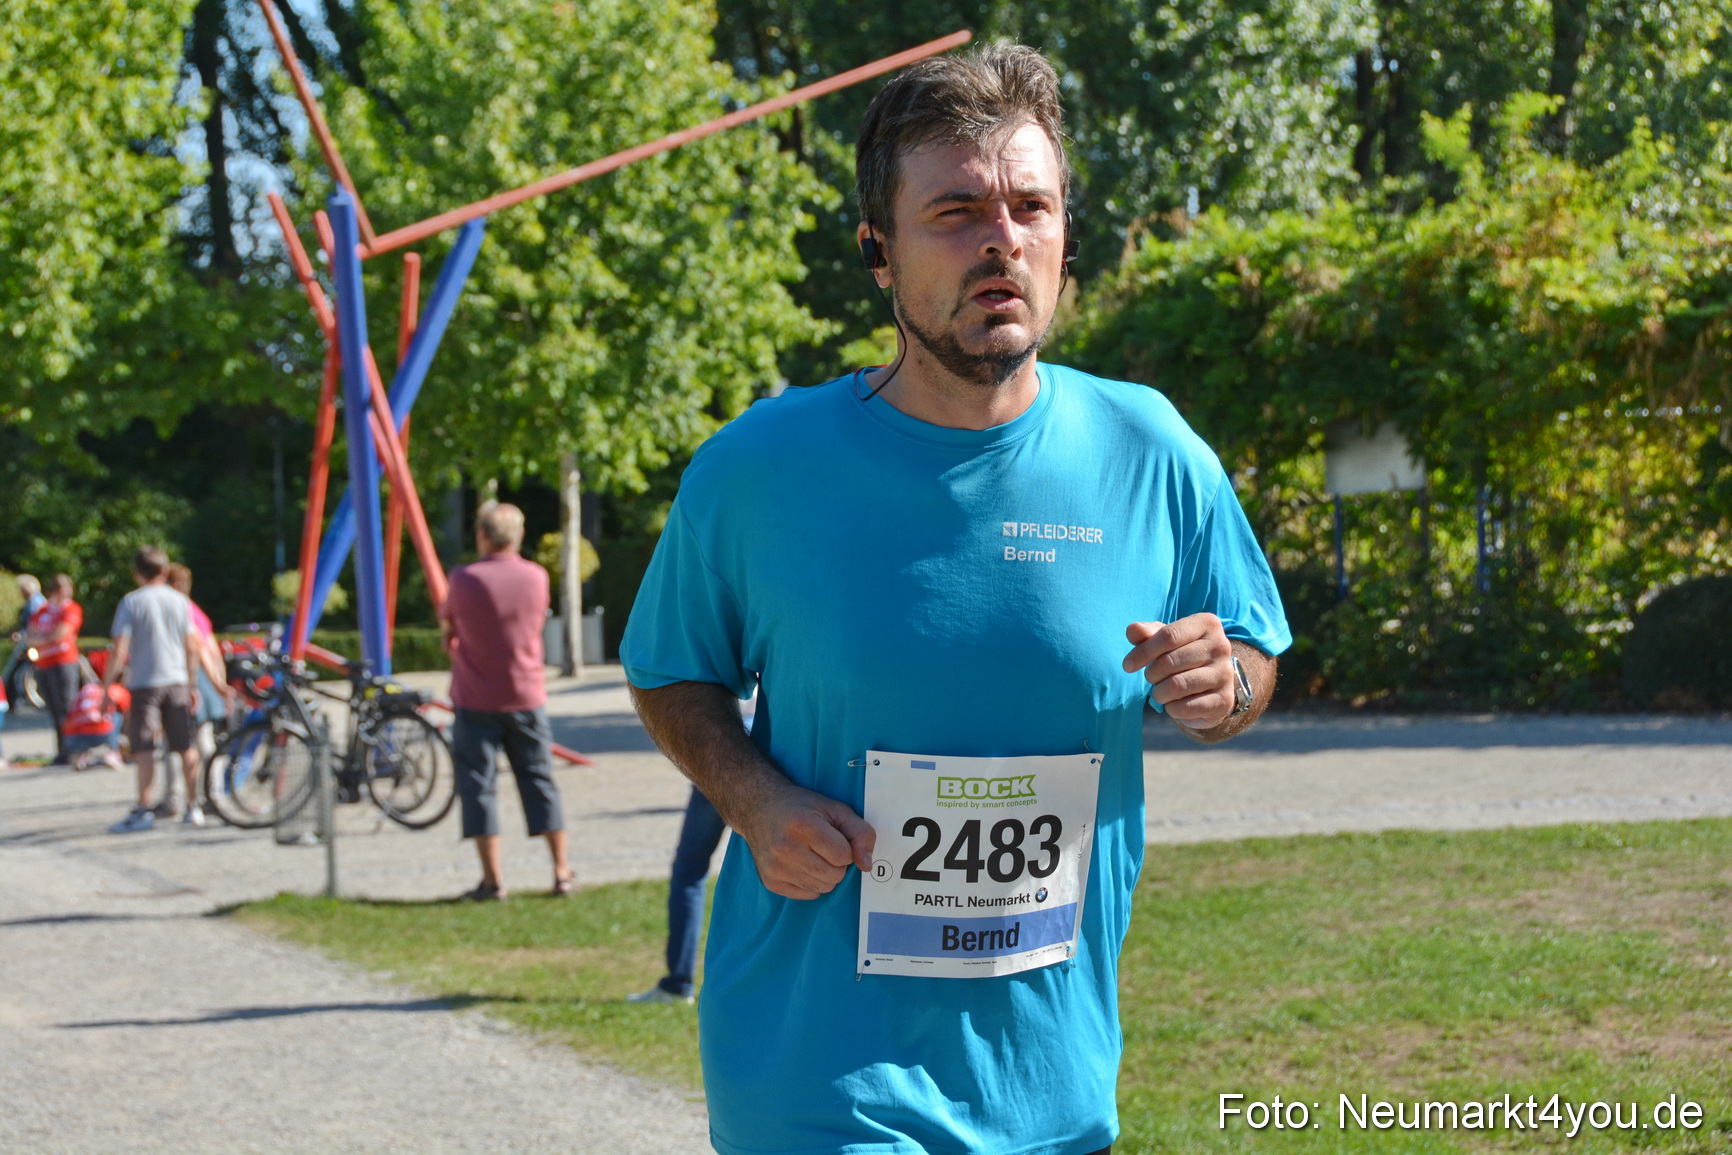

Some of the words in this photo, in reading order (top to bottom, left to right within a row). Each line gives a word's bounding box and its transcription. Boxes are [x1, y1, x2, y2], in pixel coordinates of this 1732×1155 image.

[1020, 522, 1103, 544] PFLEIDERER
[1003, 546, 1056, 562] Bernd
[937, 774, 1037, 800] BOCK
[936, 800, 968, 809] inspired
[970, 800, 980, 809] by
[982, 800, 1005, 808] smart
[1006, 798, 1038, 808] concepts
[900, 814, 1063, 884] 2483
[876, 865, 886, 878] D
[914, 893, 964, 908] PARTL
[967, 892, 1031, 908] Neumarkt
[941, 922, 1021, 952] Bernd
